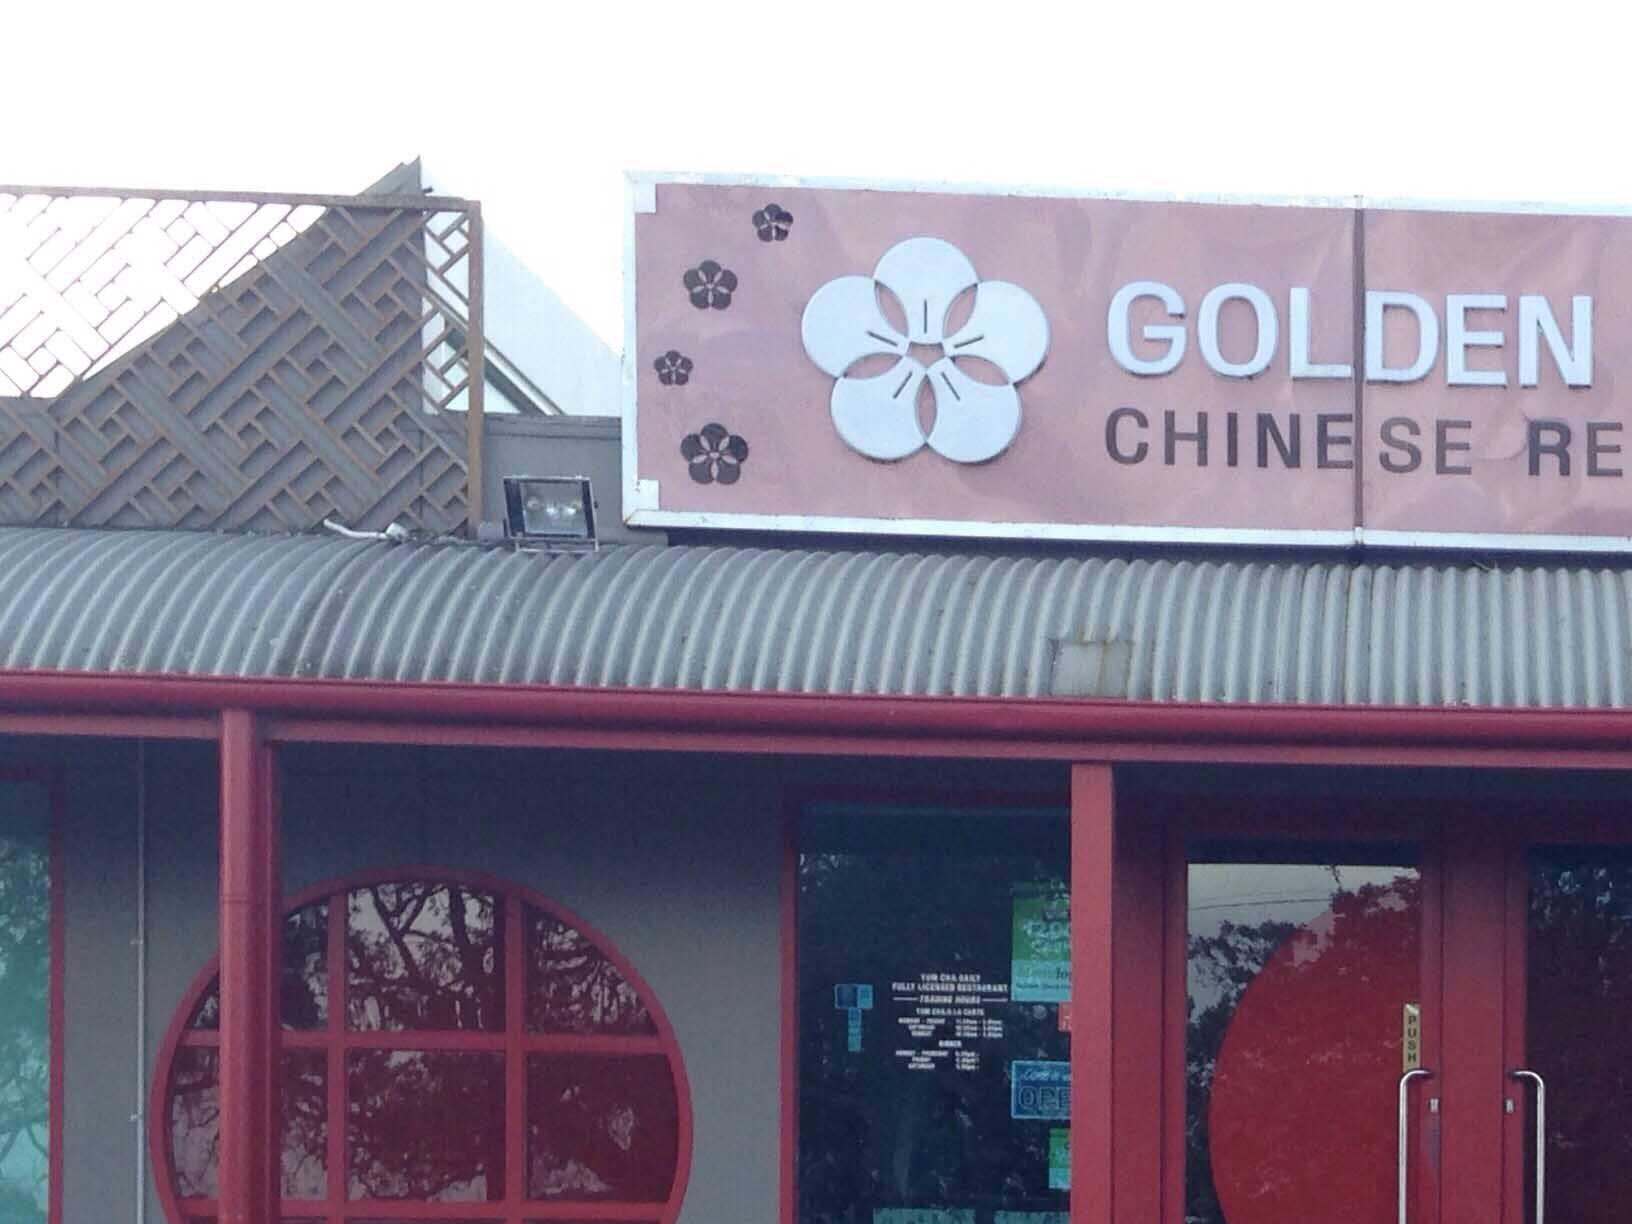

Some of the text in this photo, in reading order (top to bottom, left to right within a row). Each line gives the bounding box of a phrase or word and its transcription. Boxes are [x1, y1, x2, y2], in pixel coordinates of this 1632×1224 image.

[1106, 280, 1594, 389] GOLDEN
[1104, 407, 1473, 476] CHINESE
[1408, 1015, 1417, 1062] PUSH
[1020, 1086, 1071, 1110] OPE
